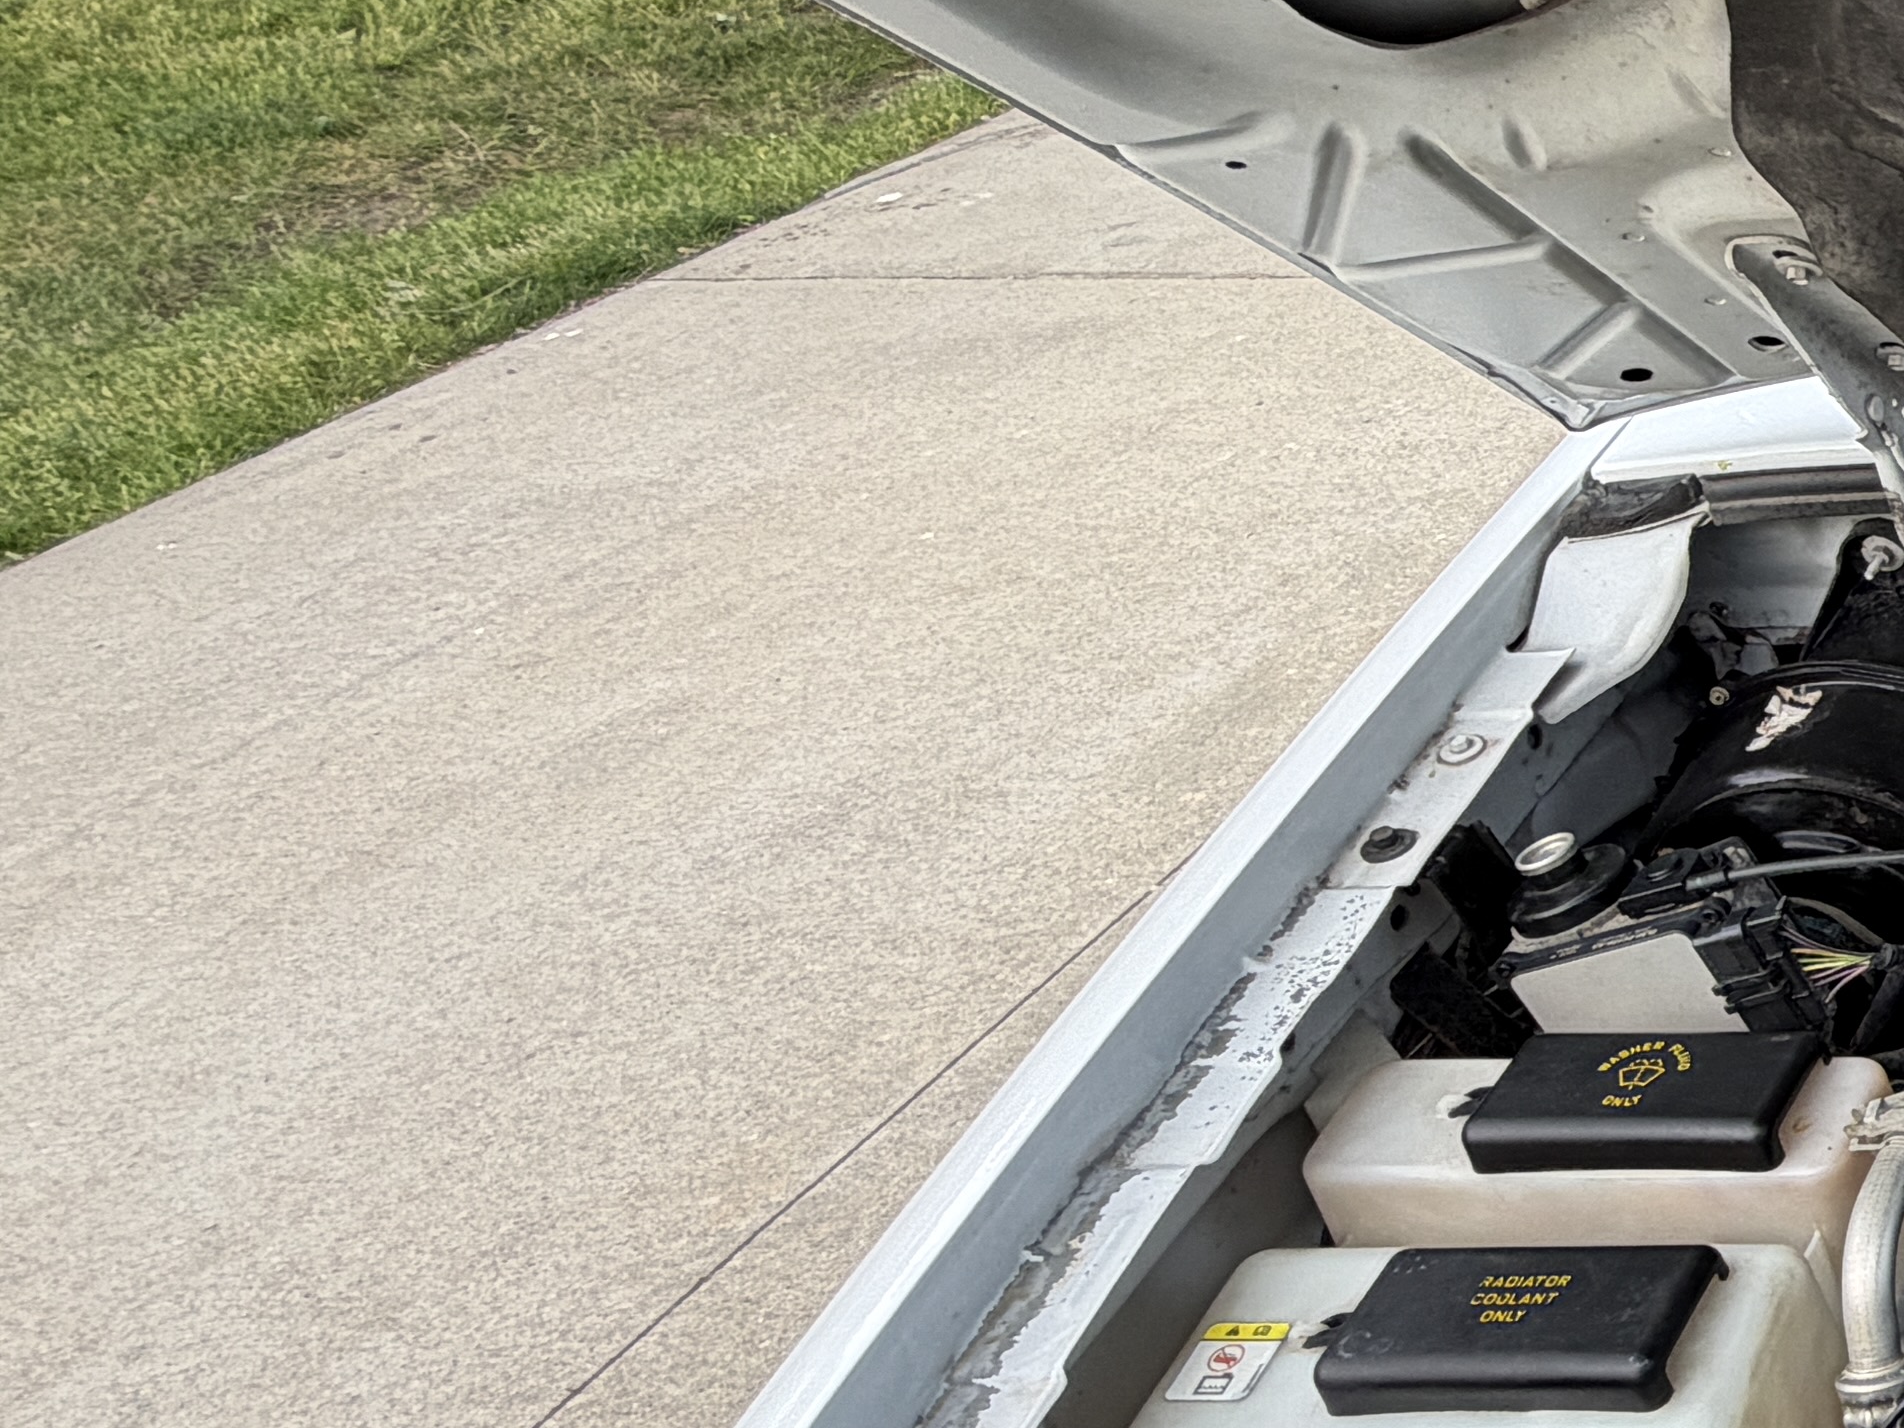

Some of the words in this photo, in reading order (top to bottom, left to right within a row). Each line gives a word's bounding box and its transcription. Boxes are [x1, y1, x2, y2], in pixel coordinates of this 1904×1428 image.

[1602, 1095, 1642, 1107] ONLY
[1479, 1275, 1572, 1288] RADIATOR
[1470, 1292, 1559, 1305] COOLANT
[1480, 1310, 1526, 1322] ONLY
